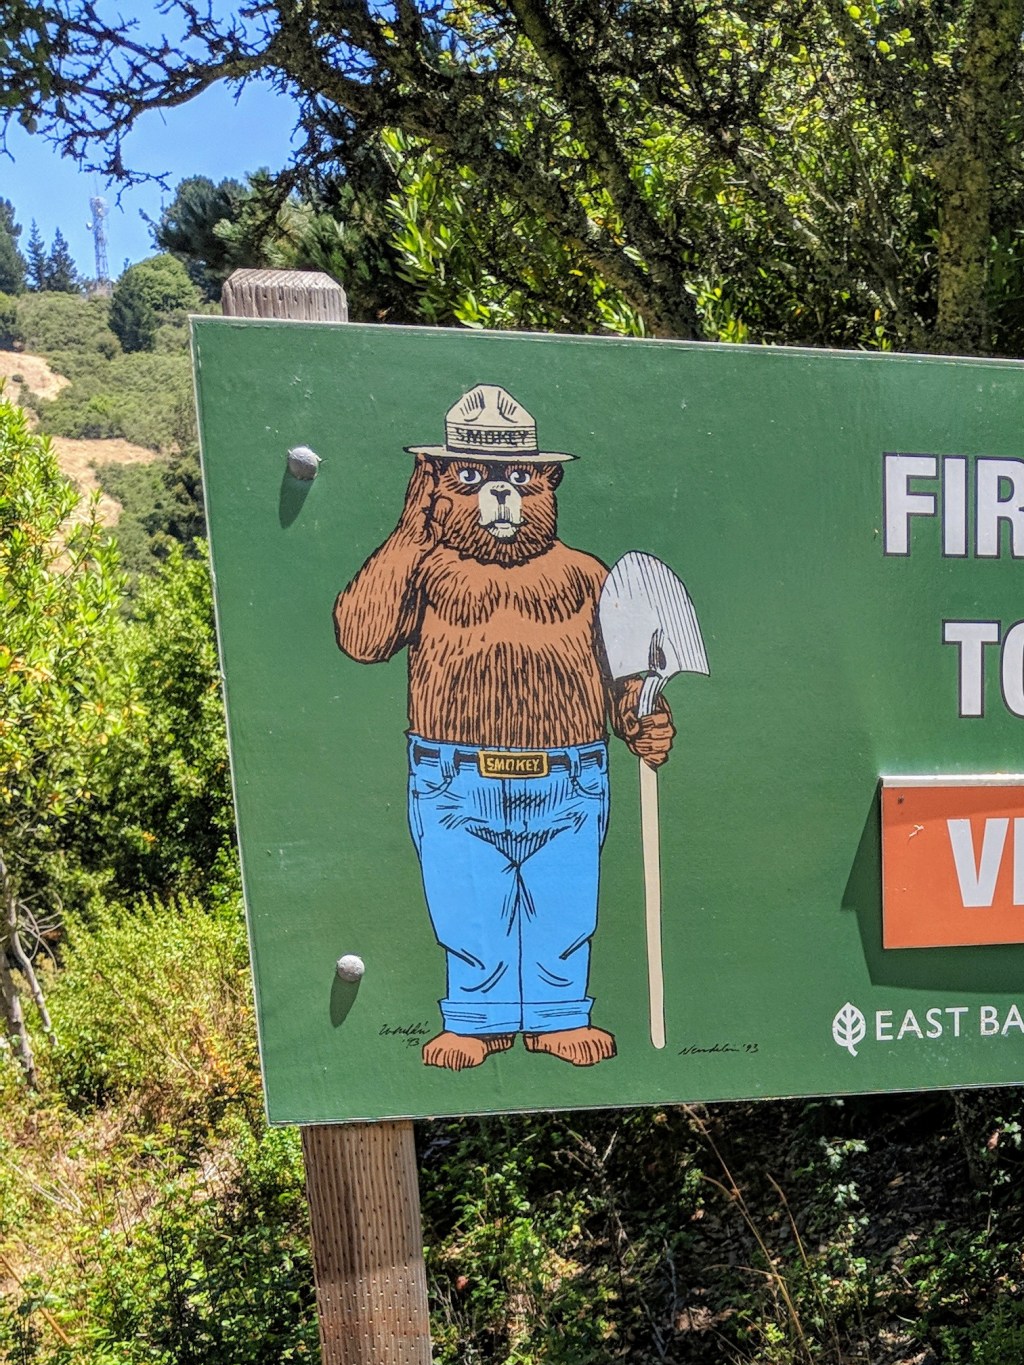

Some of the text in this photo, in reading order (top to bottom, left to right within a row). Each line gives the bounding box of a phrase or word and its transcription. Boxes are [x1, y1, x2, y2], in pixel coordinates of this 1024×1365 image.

[455, 427, 530, 445] SMOKEY
[486, 757, 540, 772] SMOKEY
[875, 1007, 969, 1041] EAST
